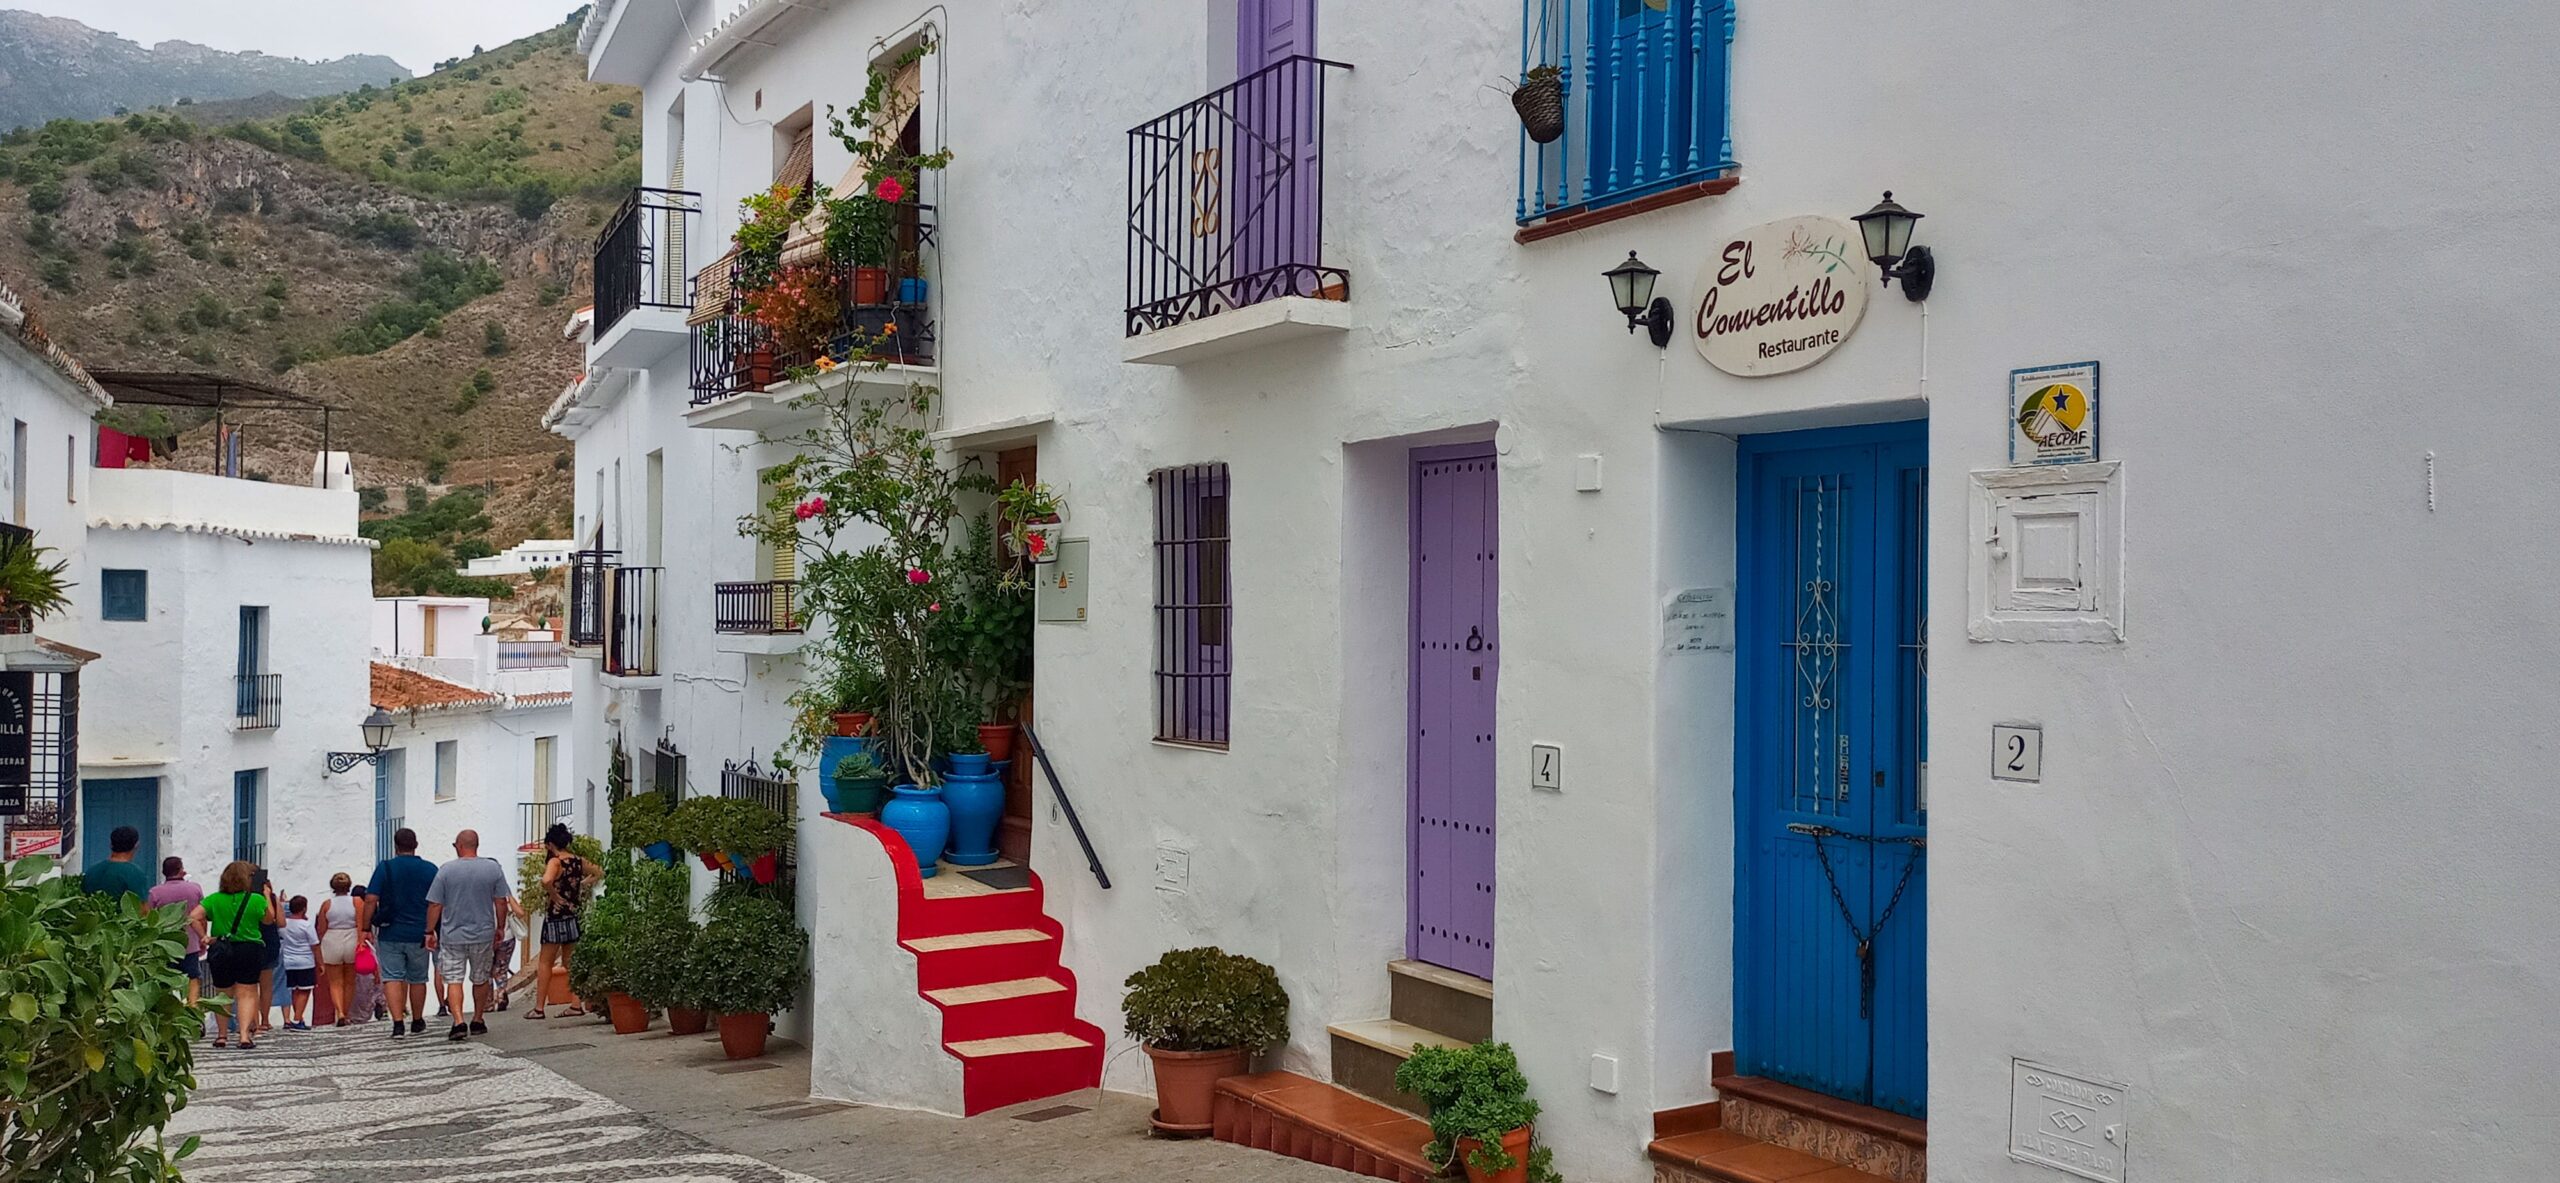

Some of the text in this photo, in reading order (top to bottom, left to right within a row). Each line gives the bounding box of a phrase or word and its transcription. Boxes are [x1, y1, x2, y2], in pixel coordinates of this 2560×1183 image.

[1717, 240, 1755, 286] El
[1697, 276, 1845, 339] Conventillo
[1758, 329, 1839, 359] Restaurante
[2038, 430, 2087, 447] AECPAF
[0, 687, 24, 719] URANTE
[1541, 753, 1550, 781] 4
[2008, 735, 2025, 771] 2
[1052, 802, 1058, 822] 6
[2045, 1078, 2095, 1103] CONTADOR
